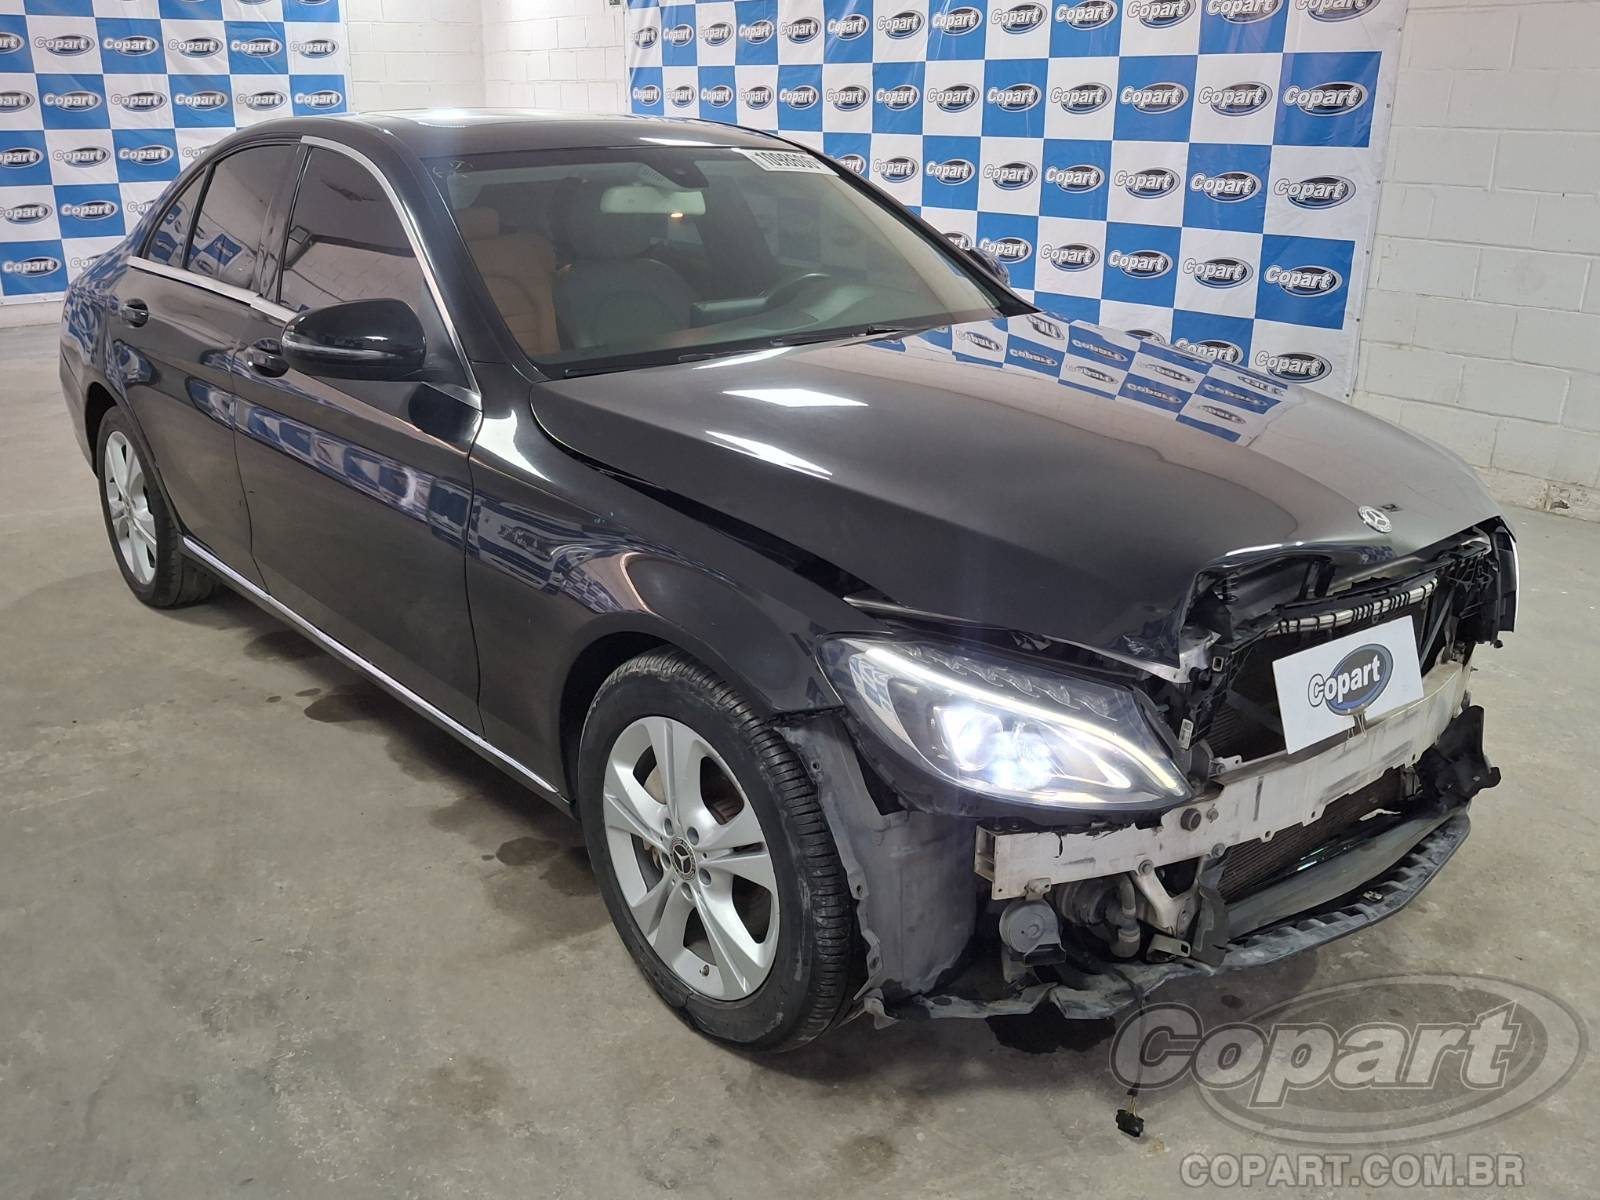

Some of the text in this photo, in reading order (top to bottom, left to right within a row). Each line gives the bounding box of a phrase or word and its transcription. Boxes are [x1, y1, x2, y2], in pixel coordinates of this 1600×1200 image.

[1056, 2, 1108, 22] Copart
[1127, 0, 1188, 21] Copart
[1208, 0, 1274, 17] Copart
[878, 15, 919, 34] Copart
[933, 11, 976, 31] Copart
[991, 8, 1040, 27] Copart
[664, 27, 690, 43] Copart
[702, 26, 729, 43] Copart
[739, 23, 771, 39] Copart
[781, 20, 817, 37] Copart
[828, 18, 865, 36] Copart
[35, 37, 88, 50] Copart
[103, 38, 152, 51] Copart
[169, 39, 216, 52] Copart
[231, 40, 277, 53] Copart
[291, 41, 332, 54] Copart
[44, 93, 94, 106] Copart
[112, 94, 159, 106] Copart
[176, 94, 222, 107] Copart
[237, 94, 281, 107] Copart
[295, 93, 336, 106] Copart
[633, 88, 658, 102] Copart
[667, 88, 693, 104] Copart
[701, 88, 729, 103] Copart
[741, 89, 771, 105] Copart
[780, 89, 815, 105] Copart
[826, 88, 864, 104] Copart
[877, 88, 916, 104] Copart
[928, 88, 973, 105] Copart
[987, 86, 1037, 105] Copart
[1051, 86, 1104, 107] Copart
[1120, 85, 1181, 107] Copart
[1199, 85, 1264, 107] Copart
[1283, 85, 1358, 107] Copart
[54, 150, 102, 163] Copart
[120, 148, 168, 161] Copart
[874, 160, 913, 176] Copart
[927, 162, 970, 180] Copart
[983, 163, 1031, 184] Copart
[1045, 166, 1098, 187] Copart
[1115, 170, 1173, 193] Copart
[1191, 174, 1252, 197] Copart
[1274, 179, 1344, 203] Copart
[61, 203, 111, 218] Copart
[1041, 244, 1090, 265] Copart
[1108, 251, 1165, 273] Copart
[3, 259, 56, 273] Copart
[1183, 258, 1245, 280] Copart
[1265, 265, 1329, 289] Copart
[1255, 352, 1321, 377] Copart
[1308, 654, 1381, 707] Copart
